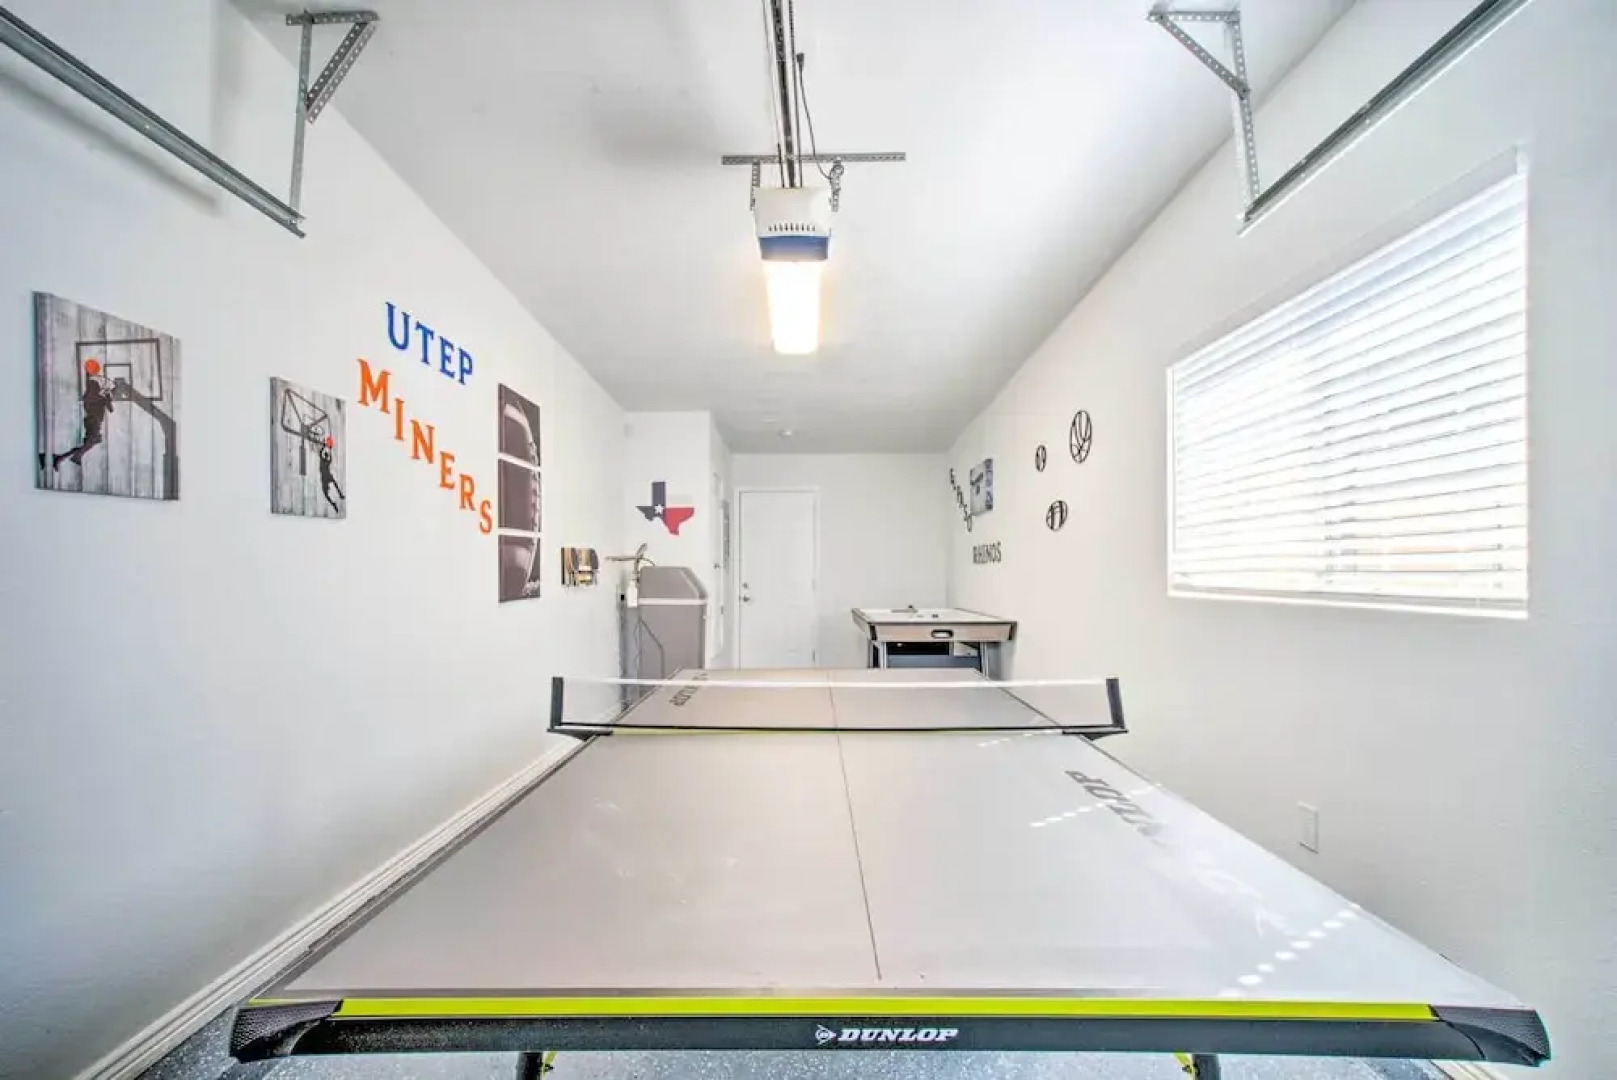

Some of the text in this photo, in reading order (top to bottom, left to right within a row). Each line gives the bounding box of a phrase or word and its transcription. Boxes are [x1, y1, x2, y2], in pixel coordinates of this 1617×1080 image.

[385, 301, 473, 385] UTEP
[357, 358, 493, 534] MINERS
[837, 1027, 959, 1042] DUNLOP
